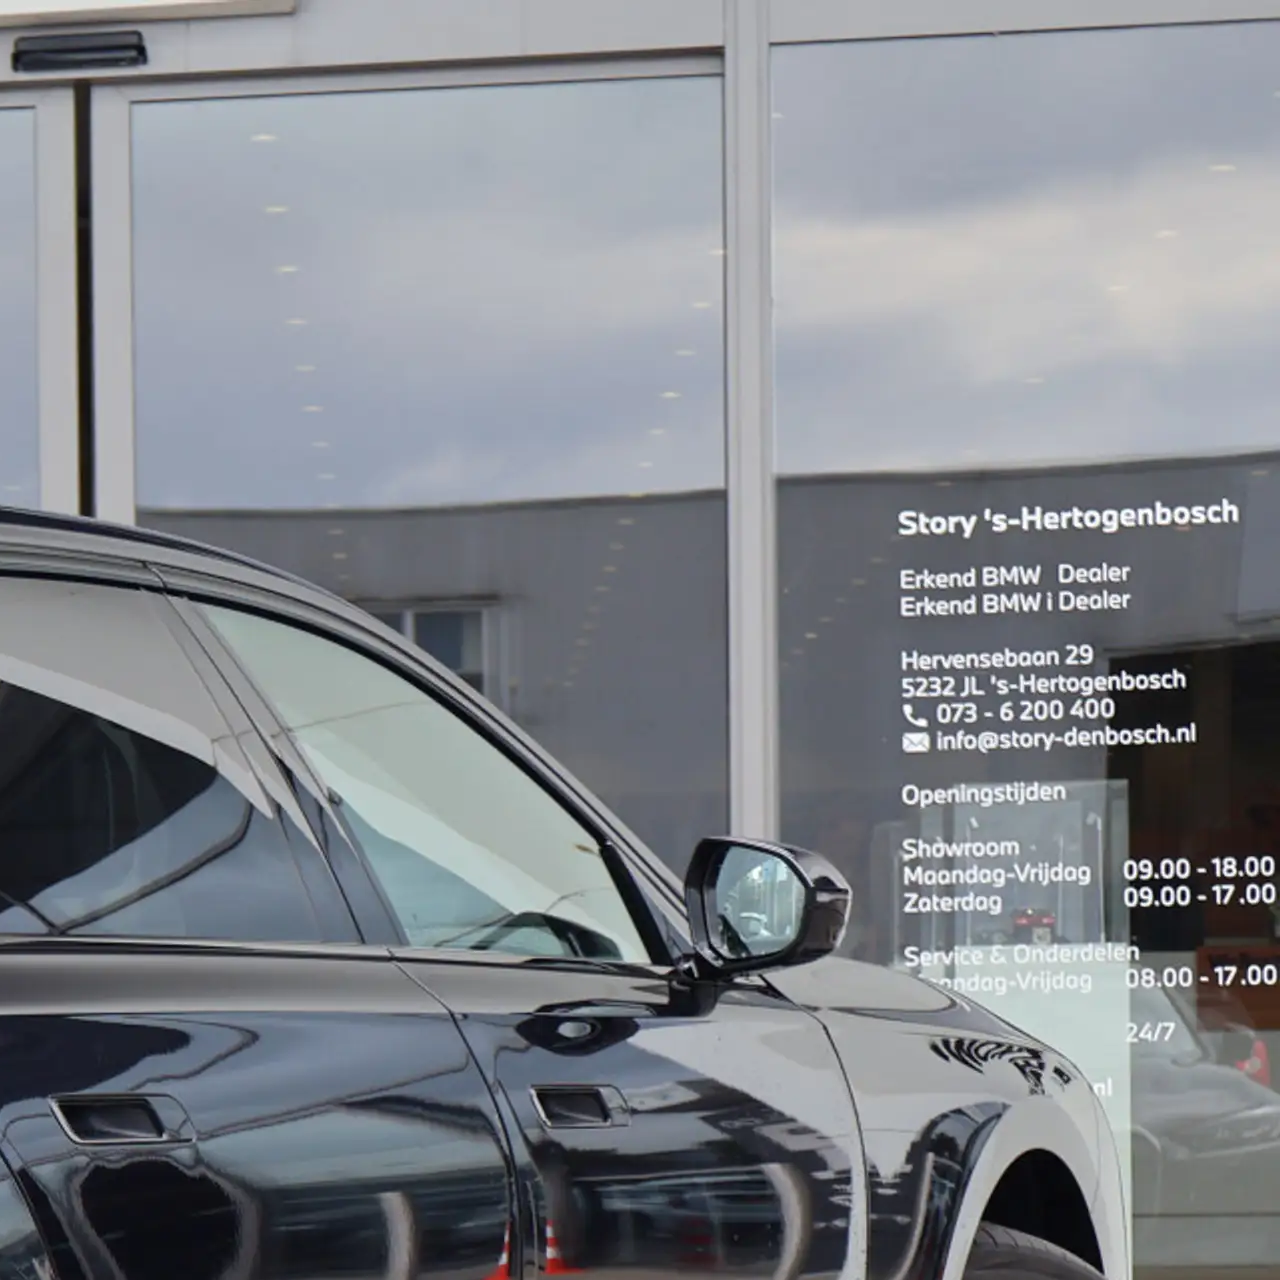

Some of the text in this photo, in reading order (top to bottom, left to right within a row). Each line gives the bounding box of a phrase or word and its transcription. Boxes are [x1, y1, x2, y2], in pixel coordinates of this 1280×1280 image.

[898, 499, 1239, 538] Story 's-Hertogenbosch
[900, 563, 1131, 589] Erkend BMW Dealer
[901, 590, 1131, 616] Erkend BMW i Dealer
[901, 645, 1093, 670] Hervensebaan 29
[902, 670, 1186, 697] 5232 JL 's-Hertogenbosch
[937, 703, 976, 724] 073
[1000, 702, 1013, 720] 6
[1020, 700, 1063, 719] 200
[1070, 698, 1115, 718] 400
[937, 724, 1196, 753] info@story-denbosch.nl
[902, 782, 1066, 807] Openingstijden
[903, 838, 1019, 860] Showroom
[904, 862, 1091, 885] Maandag-Vrijdag
[1124, 859, 1190, 880] 09.00
[1212, 856, 1275, 877] 18.00
[904, 892, 1002, 915] Zaterdag
[1124, 886, 1190, 907] 09.00
[904, 943, 1139, 968] Service & Onderdelen
[918, 968, 1092, 994] andag-Vrijdag
[1125, 968, 1192, 988] 08.00
[1126, 1023, 1174, 1043] 24/7
